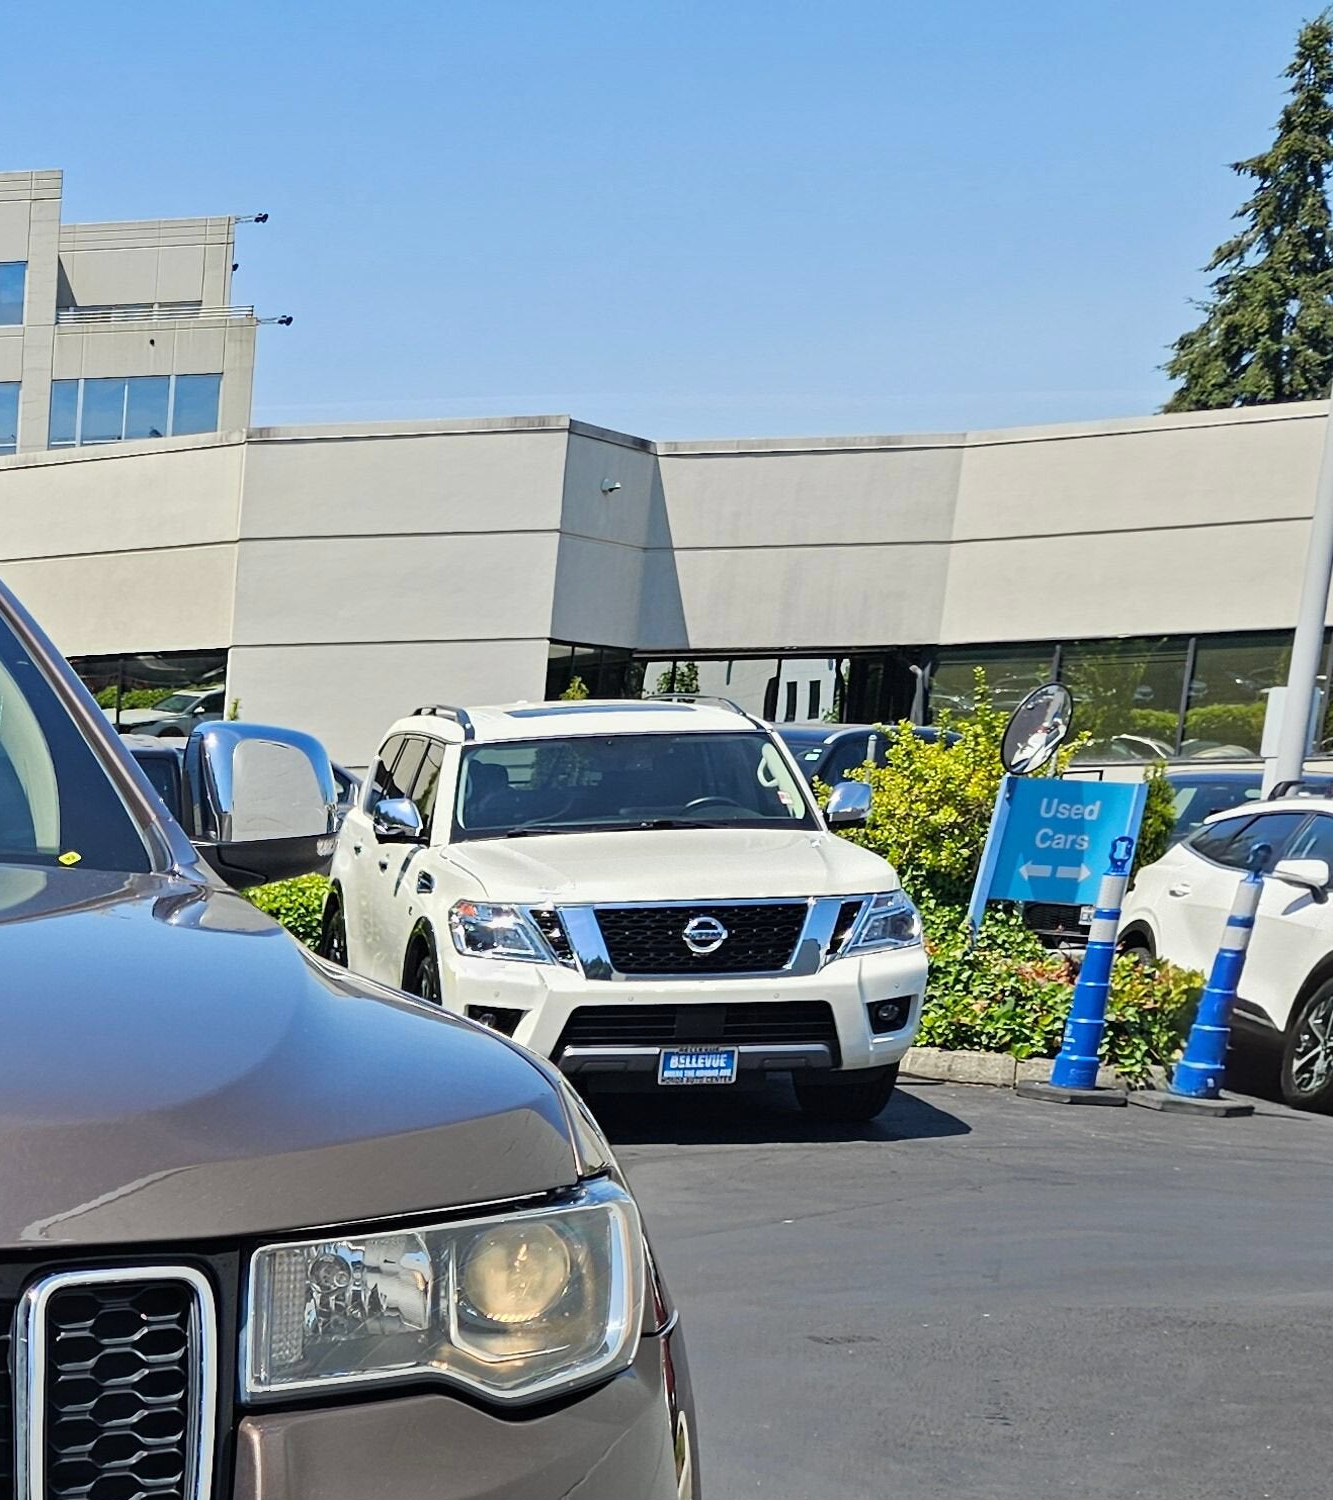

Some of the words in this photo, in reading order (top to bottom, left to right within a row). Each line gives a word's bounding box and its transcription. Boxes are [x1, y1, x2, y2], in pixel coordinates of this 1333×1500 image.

[1039, 798, 1102, 821] Used
[1035, 828, 1090, 850] Cars
[670, 1054, 727, 1069] BELLEVUE
